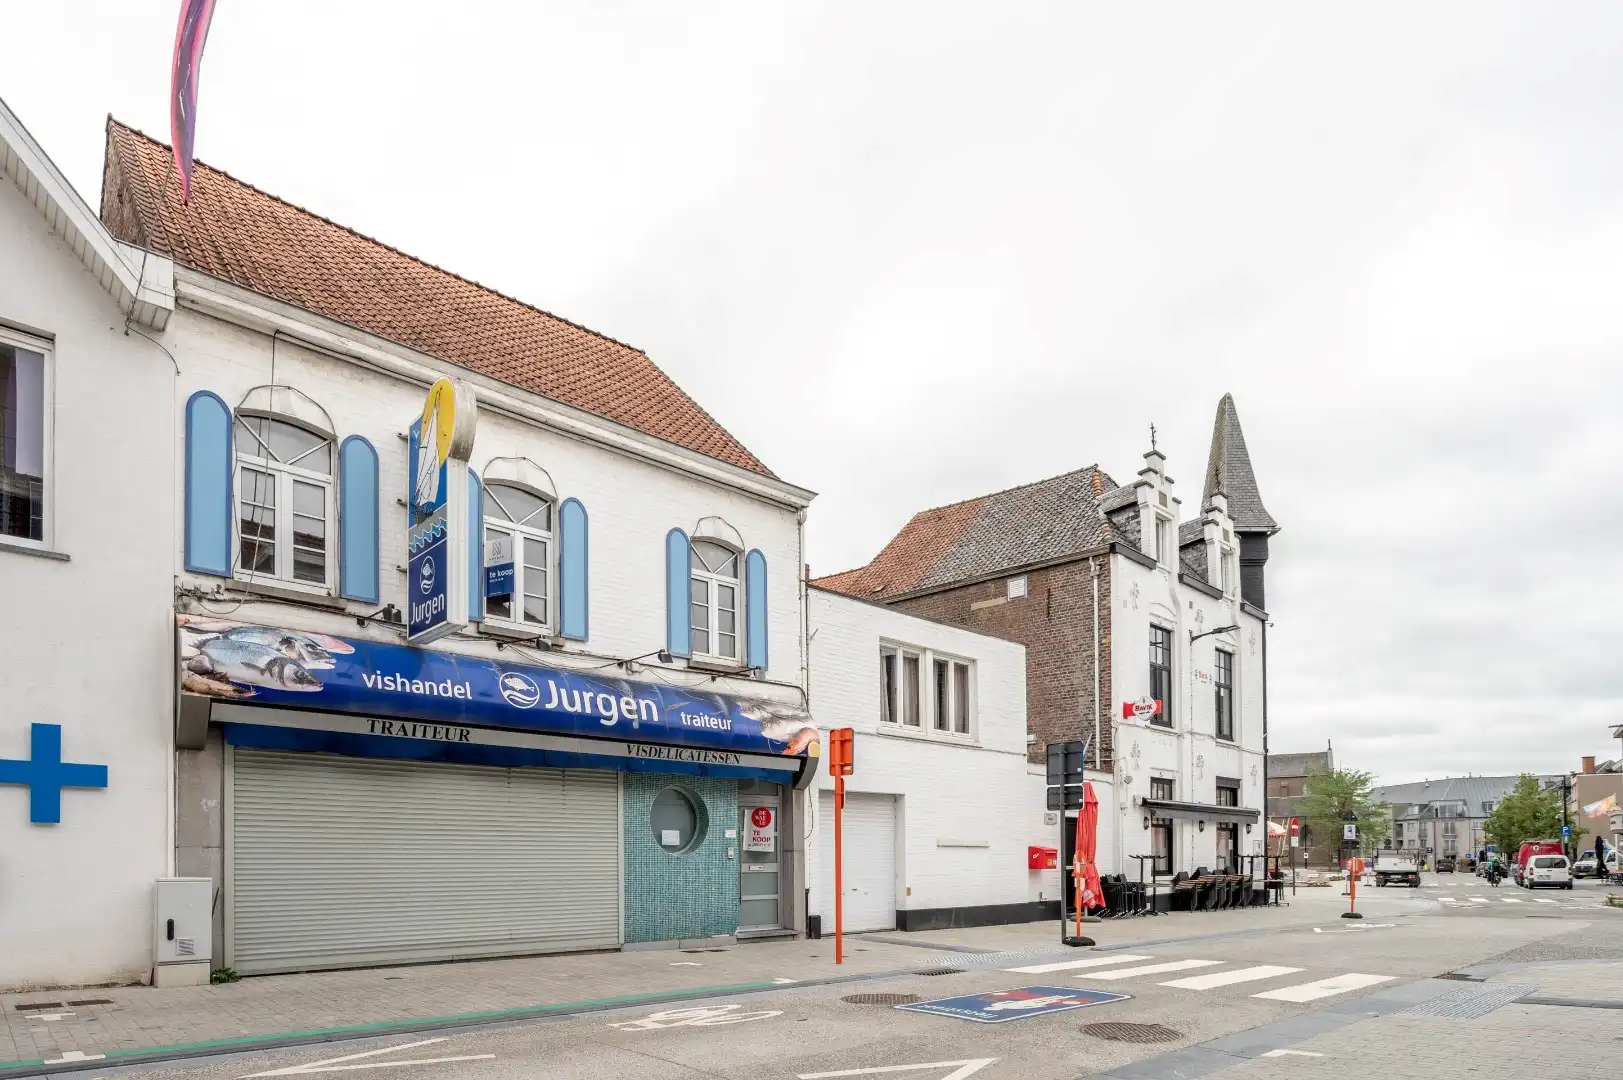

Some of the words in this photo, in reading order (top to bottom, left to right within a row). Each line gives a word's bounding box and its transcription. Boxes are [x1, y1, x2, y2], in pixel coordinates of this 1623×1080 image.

[498, 568, 513, 577] koop
[411, 593, 445, 625] Jurgen
[362, 670, 473, 700] vishandel
[545, 679, 660, 727] Jurgen
[680, 710, 733, 731] traiteur
[1134, 703, 1153, 712] BAVIK
[366, 718, 472, 743] TRAITEUR
[626, 743, 743, 766] VISDELICATESSEN
